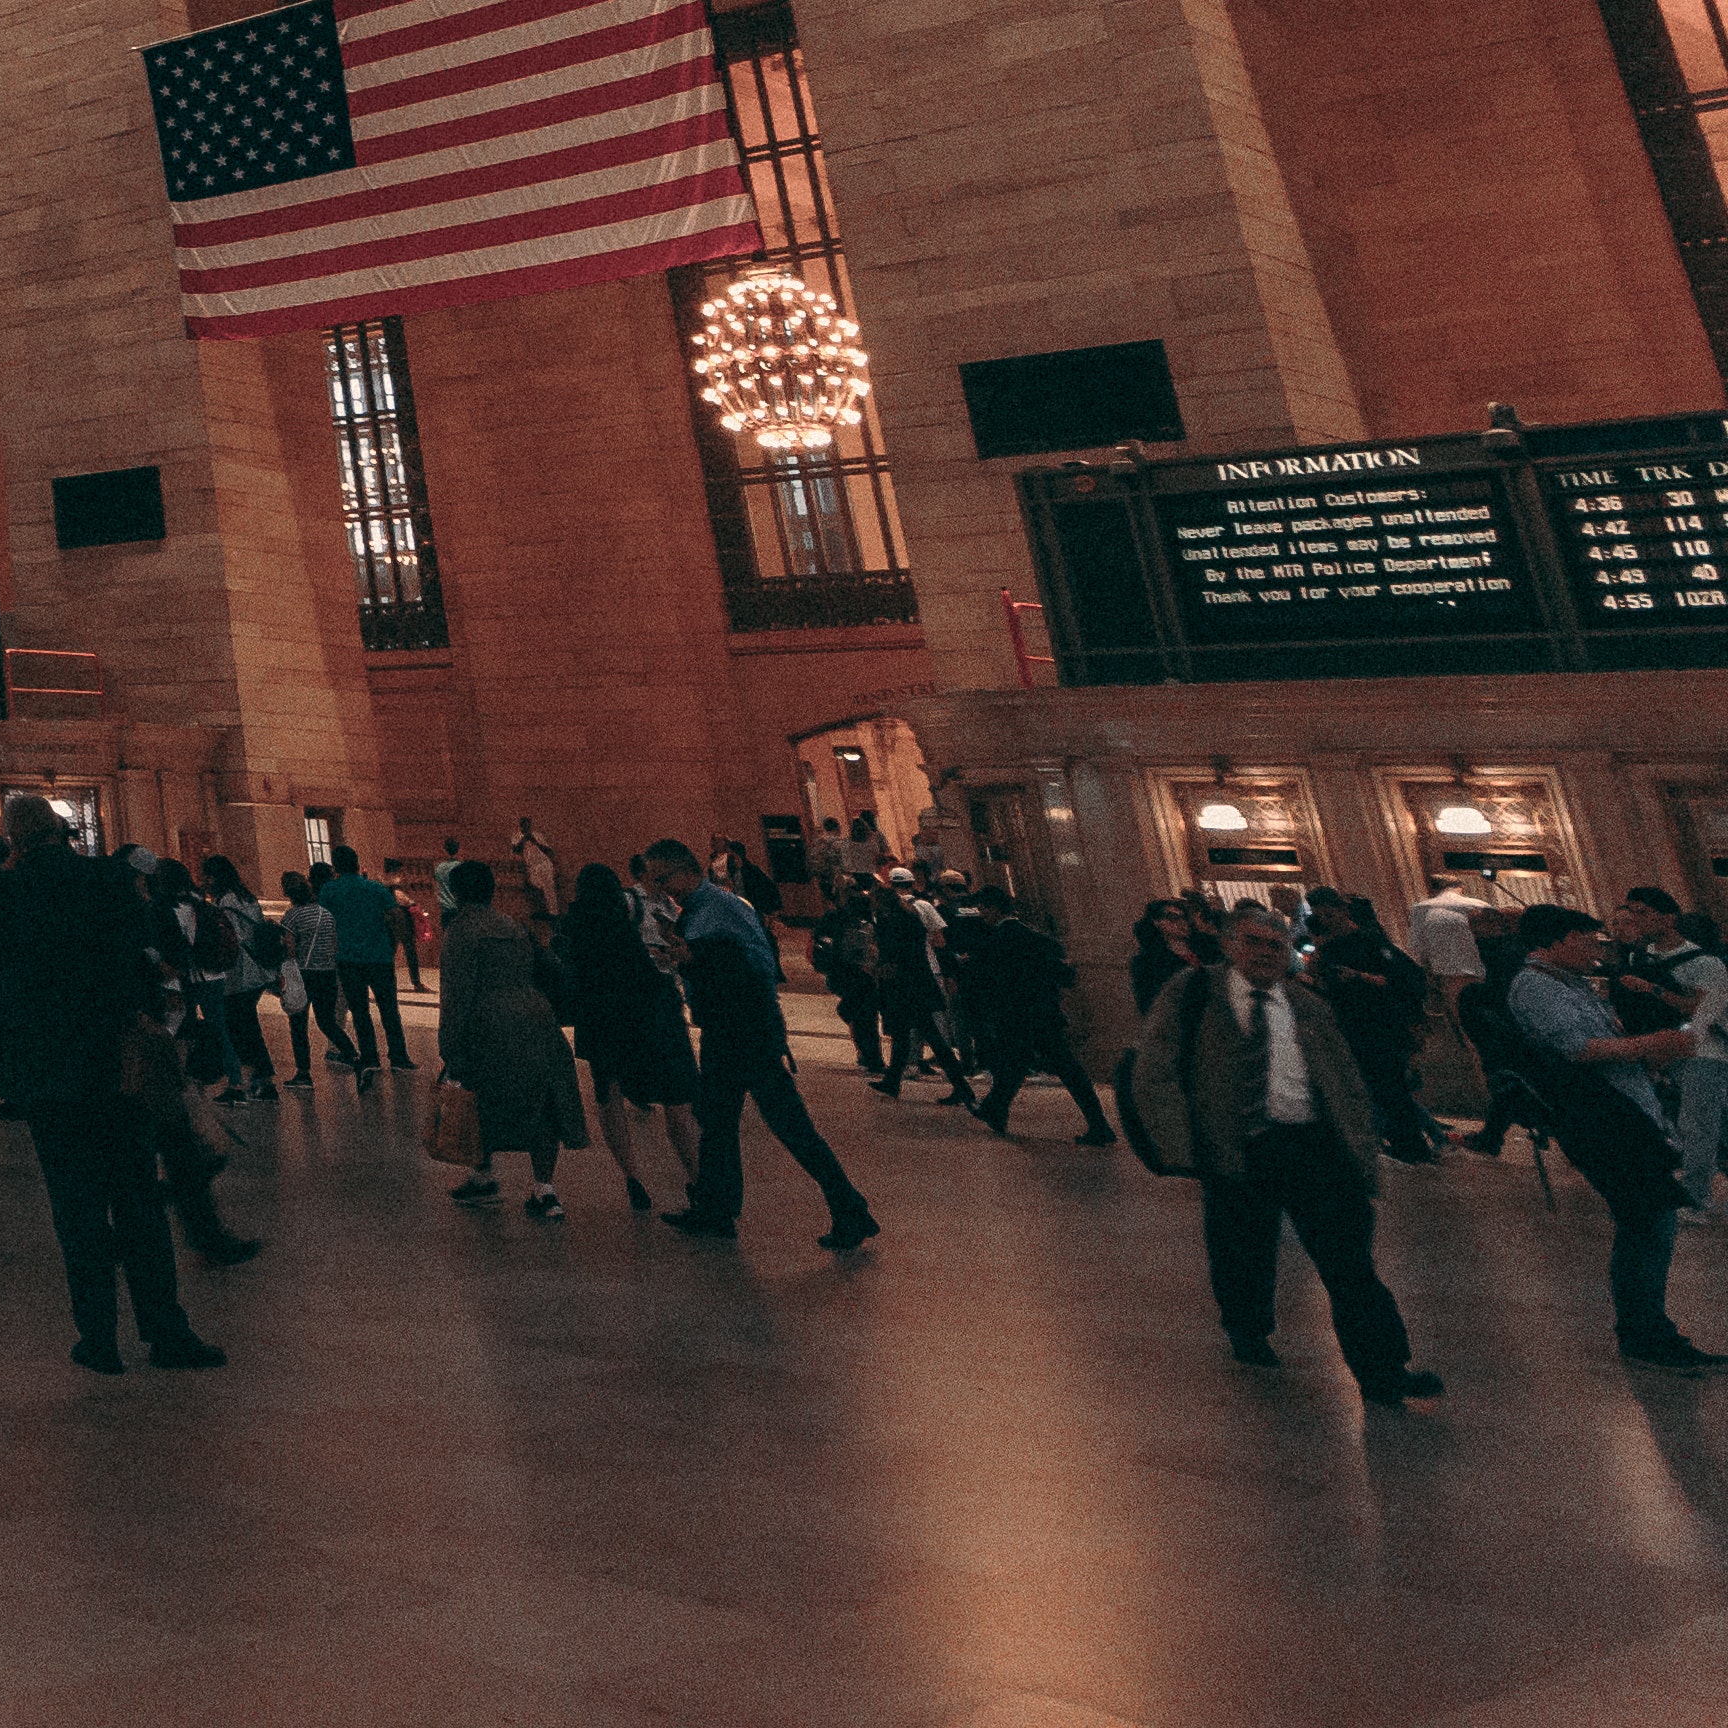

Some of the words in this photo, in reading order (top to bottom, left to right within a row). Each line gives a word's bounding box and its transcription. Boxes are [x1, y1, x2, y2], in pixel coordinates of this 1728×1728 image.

[1217, 448, 1421, 480] INFORMATION
[1555, 471, 1619, 488] TIME
[1634, 464, 1694, 482] TRK
[1325, 488, 1428, 507] Customers:
[1177, 525, 1225, 539] Never
[1234, 521, 1284, 536] leave
[1291, 515, 1374, 533] packages
[1382, 506, 1491, 526] unattended
[1581, 519, 1631, 536] 4:42
[1289, 540, 1339, 555] items
[1347, 538, 1379, 553] may
[1386, 535, 1411, 550] be
[1418, 529, 1497, 547] removed
[1587, 543, 1639, 561] 4:45
[1236, 567, 1266, 580] the
[1312, 561, 1376, 577] Police
[1383, 551, 1492, 573] Department
[1202, 590, 1253, 605] Thank
[1258, 589, 1292, 603] you
[1299, 586, 1330, 601] for
[1337, 583, 1382, 601] your
[1390, 577, 1512, 597] cooperation
[1603, 593, 1654, 610] 4:55
